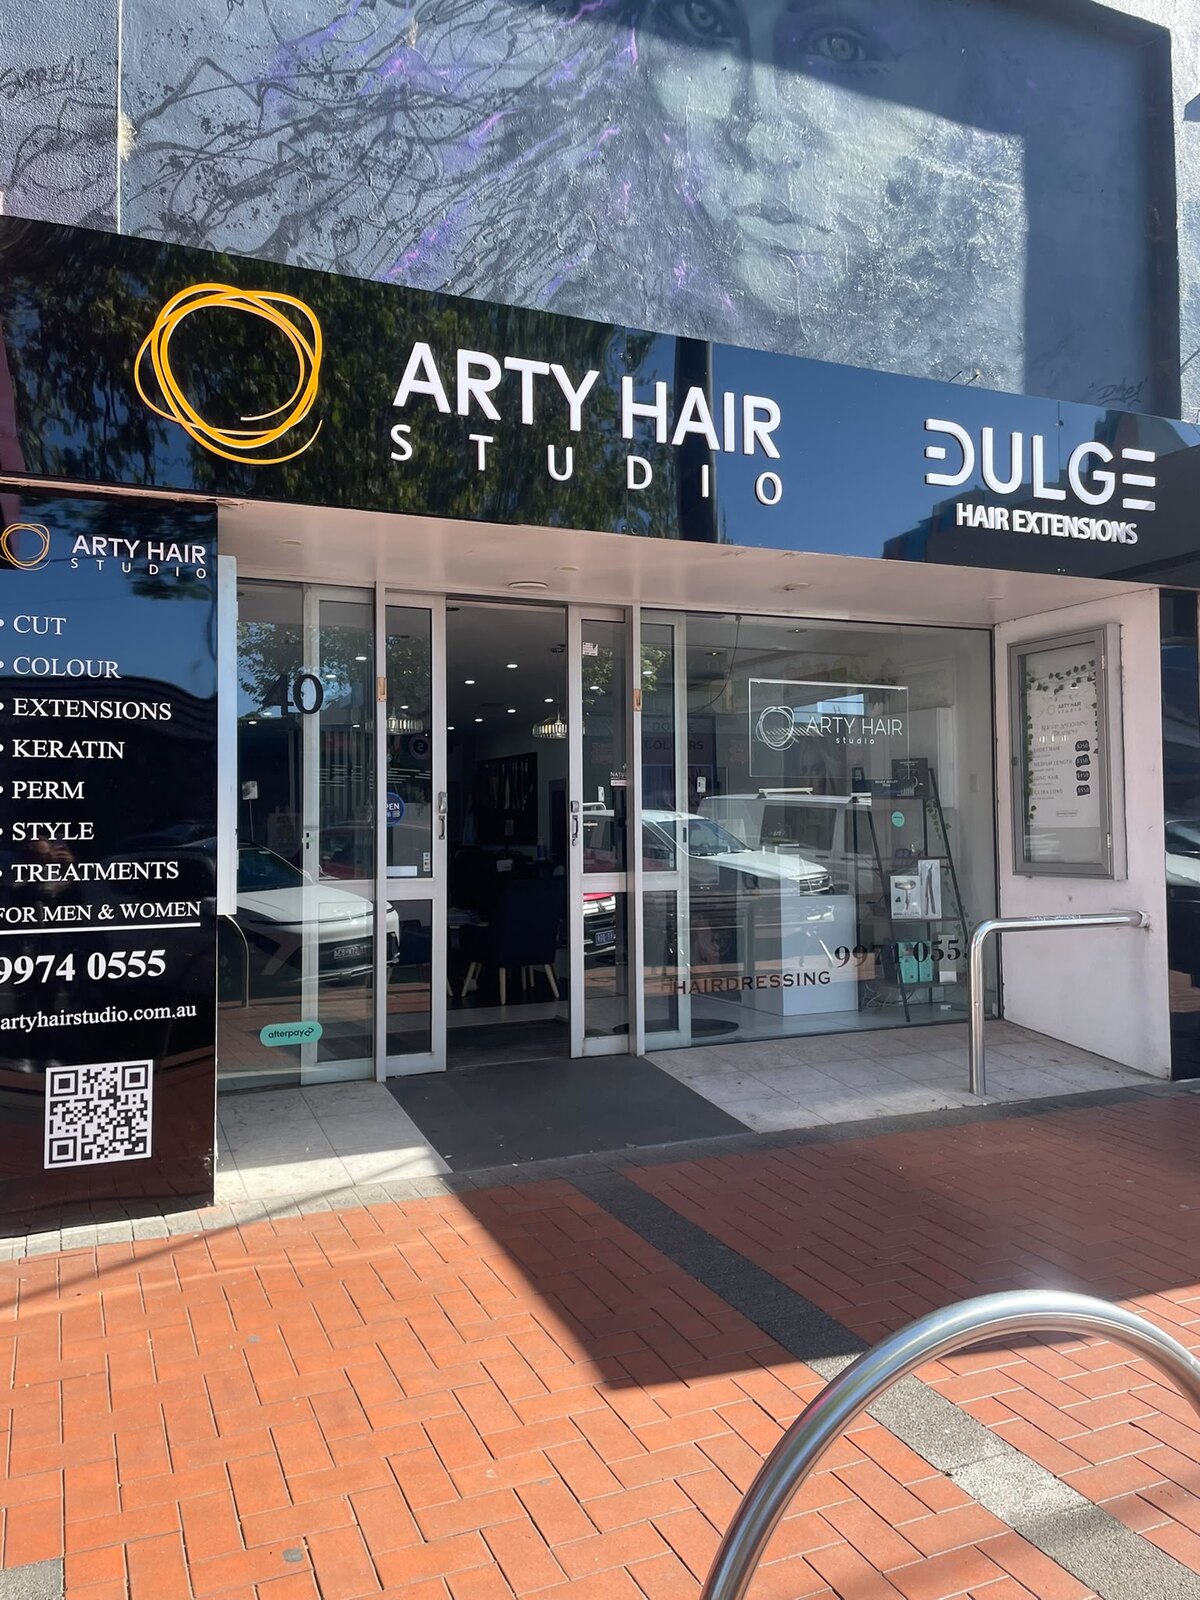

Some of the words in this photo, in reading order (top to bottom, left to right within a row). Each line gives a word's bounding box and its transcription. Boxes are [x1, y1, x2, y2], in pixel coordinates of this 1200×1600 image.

[392, 342, 600, 432] ARTY
[621, 376, 781, 459] HAIR
[390, 424, 783, 506] STUDIO
[956, 502, 1010, 531] HAIR
[1013, 509, 1139, 545] EXTENSIONS
[72, 535, 140, 558] ARTY
[147, 541, 206, 565] HAIR
[70, 557, 207, 579] STUDIO
[13, 615, 67, 636] CUT
[13, 656, 122, 679] COLOUR
[262, 672, 324, 718] 40
[12, 698, 173, 721] EXTENSIONS
[806, 716, 856, 735] ARTY
[862, 719, 903, 736] HAIR
[12, 739, 126, 760] KERATIN
[835, 737, 875, 745] studio
[12, 781, 85, 800] PERM
[12, 822, 95, 841] STYLE
[11, 861, 179, 883] TREATMENTS
[42, 905, 92, 922] MEN
[97, 904, 115, 920] &
[120, 901, 201, 919] WOMEN
[0, 954, 76, 985] 9974
[87, 949, 167, 981] 0555
[673, 971, 832, 995] HAIRDRESSING
[0, 1004, 197, 1033] artyhairstudio.com.au
[268, 1028, 305, 1040] afterpay
